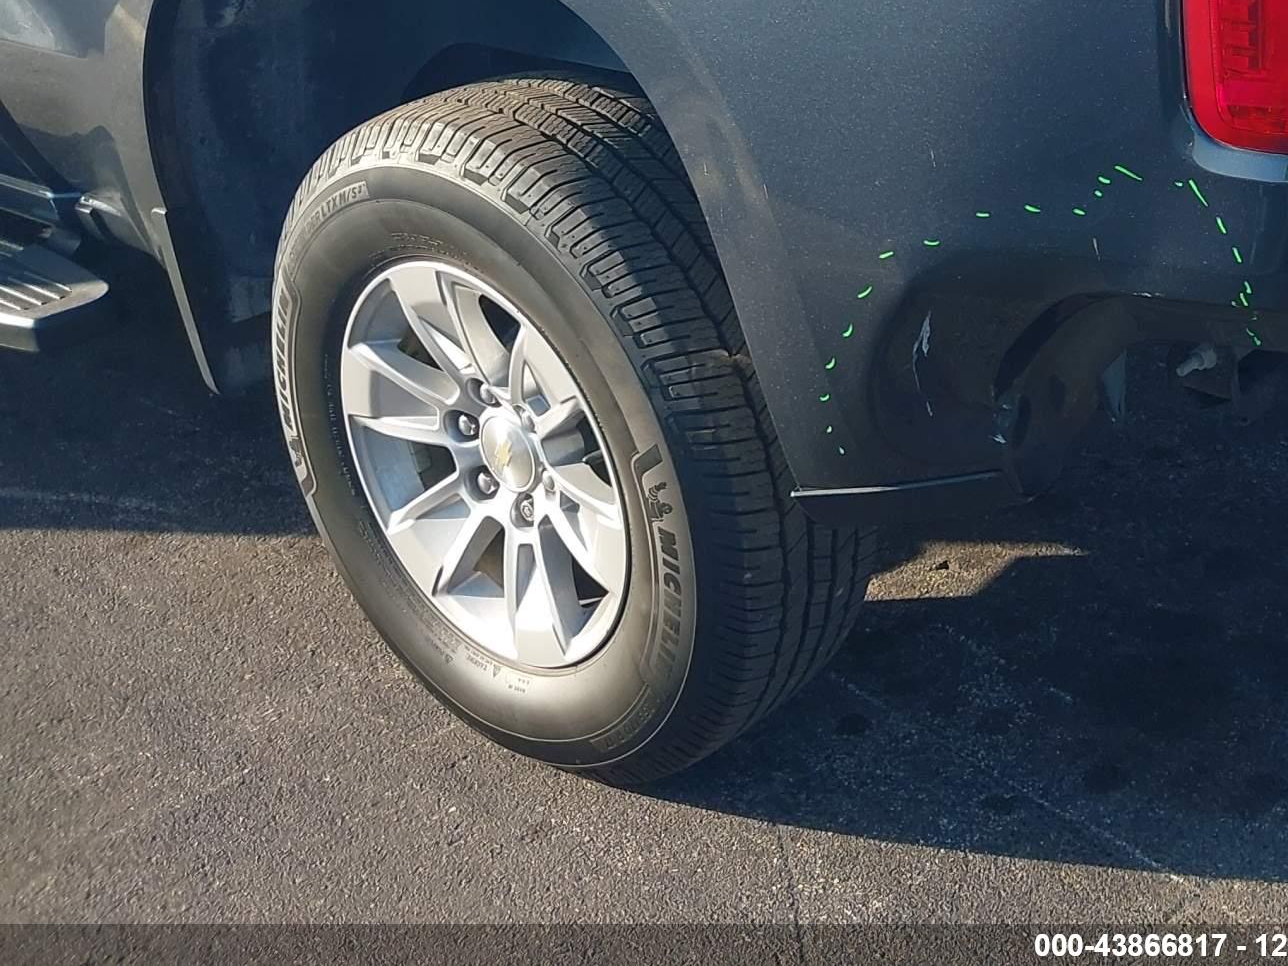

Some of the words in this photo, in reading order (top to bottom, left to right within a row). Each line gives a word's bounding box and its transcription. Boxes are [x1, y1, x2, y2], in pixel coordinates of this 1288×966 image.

[320, 195, 339, 218] LTX
[275, 287, 295, 433] MICHELIN
[654, 526, 681, 681] MICHELIN
